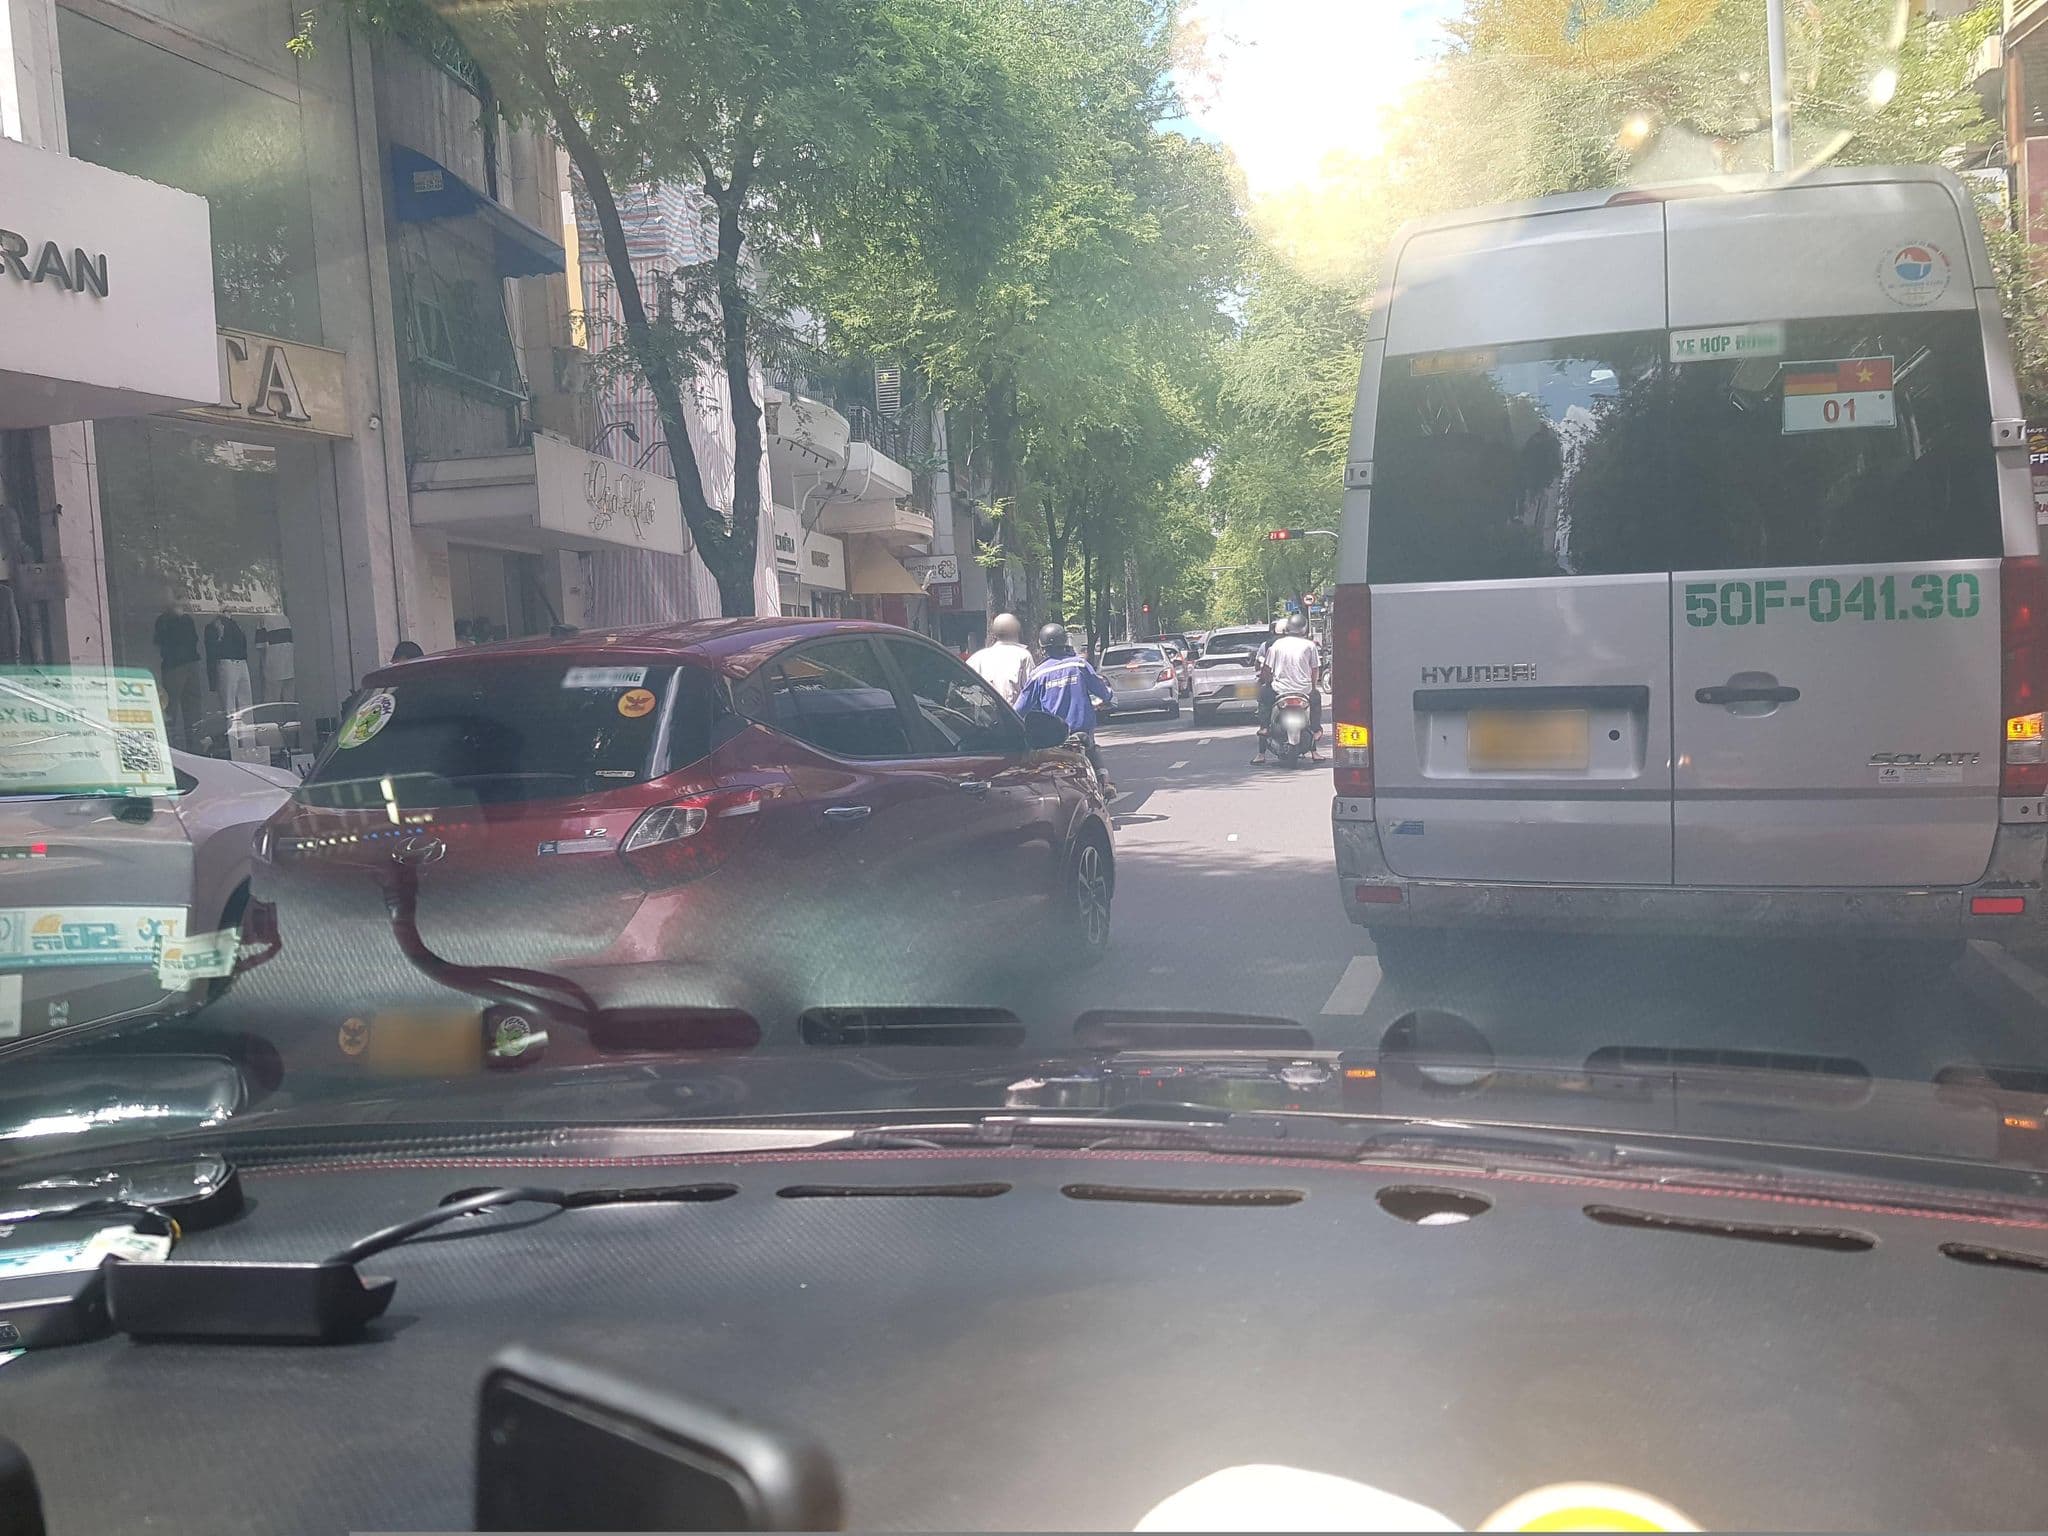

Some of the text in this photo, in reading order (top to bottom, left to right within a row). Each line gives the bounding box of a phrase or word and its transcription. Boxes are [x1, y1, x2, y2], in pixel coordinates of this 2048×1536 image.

[0, 229, 109, 298] RAN
[1823, 398, 1856, 423] 01
[1685, 573, 1980, 627] 50F-041.30
[1421, 663, 1537, 683] HYUNDAI
